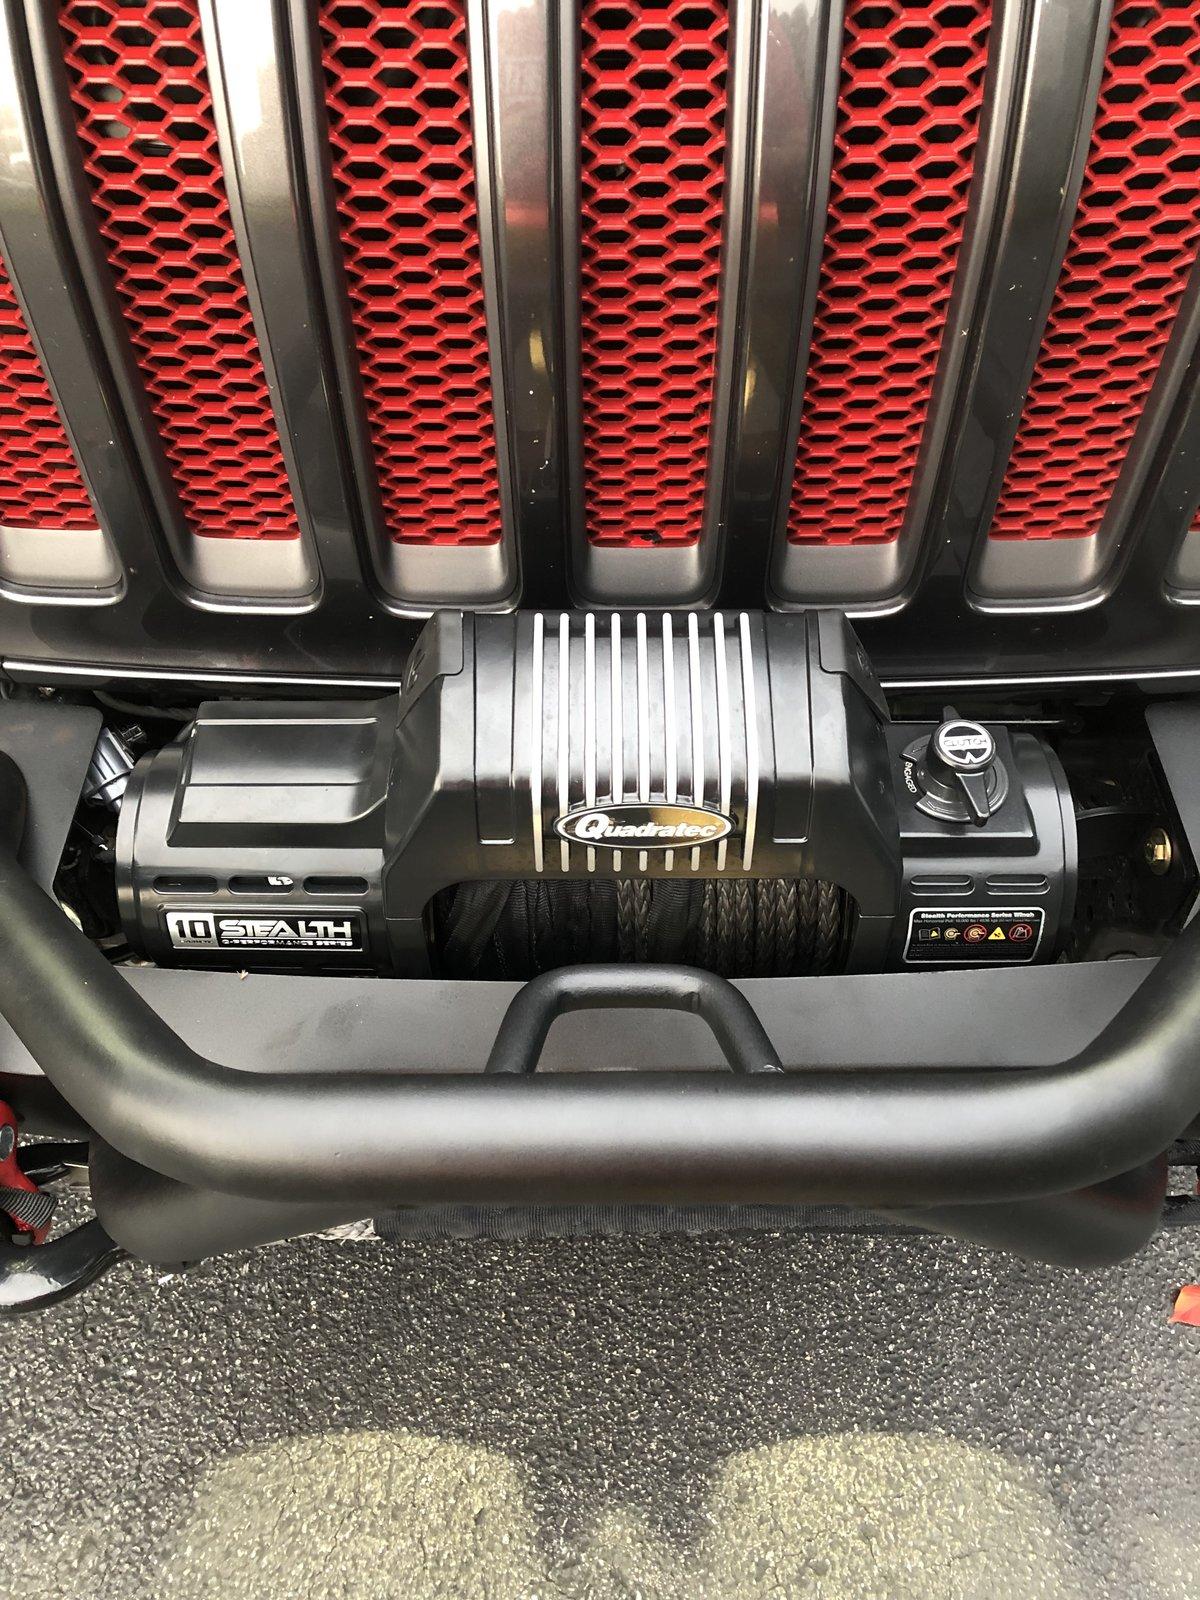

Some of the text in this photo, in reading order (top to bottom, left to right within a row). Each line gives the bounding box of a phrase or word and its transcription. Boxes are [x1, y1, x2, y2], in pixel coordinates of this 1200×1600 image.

[943, 738, 987, 747] CLUTCH
[903, 761, 918, 794] ENGAGED
[574, 813, 717, 840] Quadratec
[175, 919, 352, 938] 10 STEALTH
